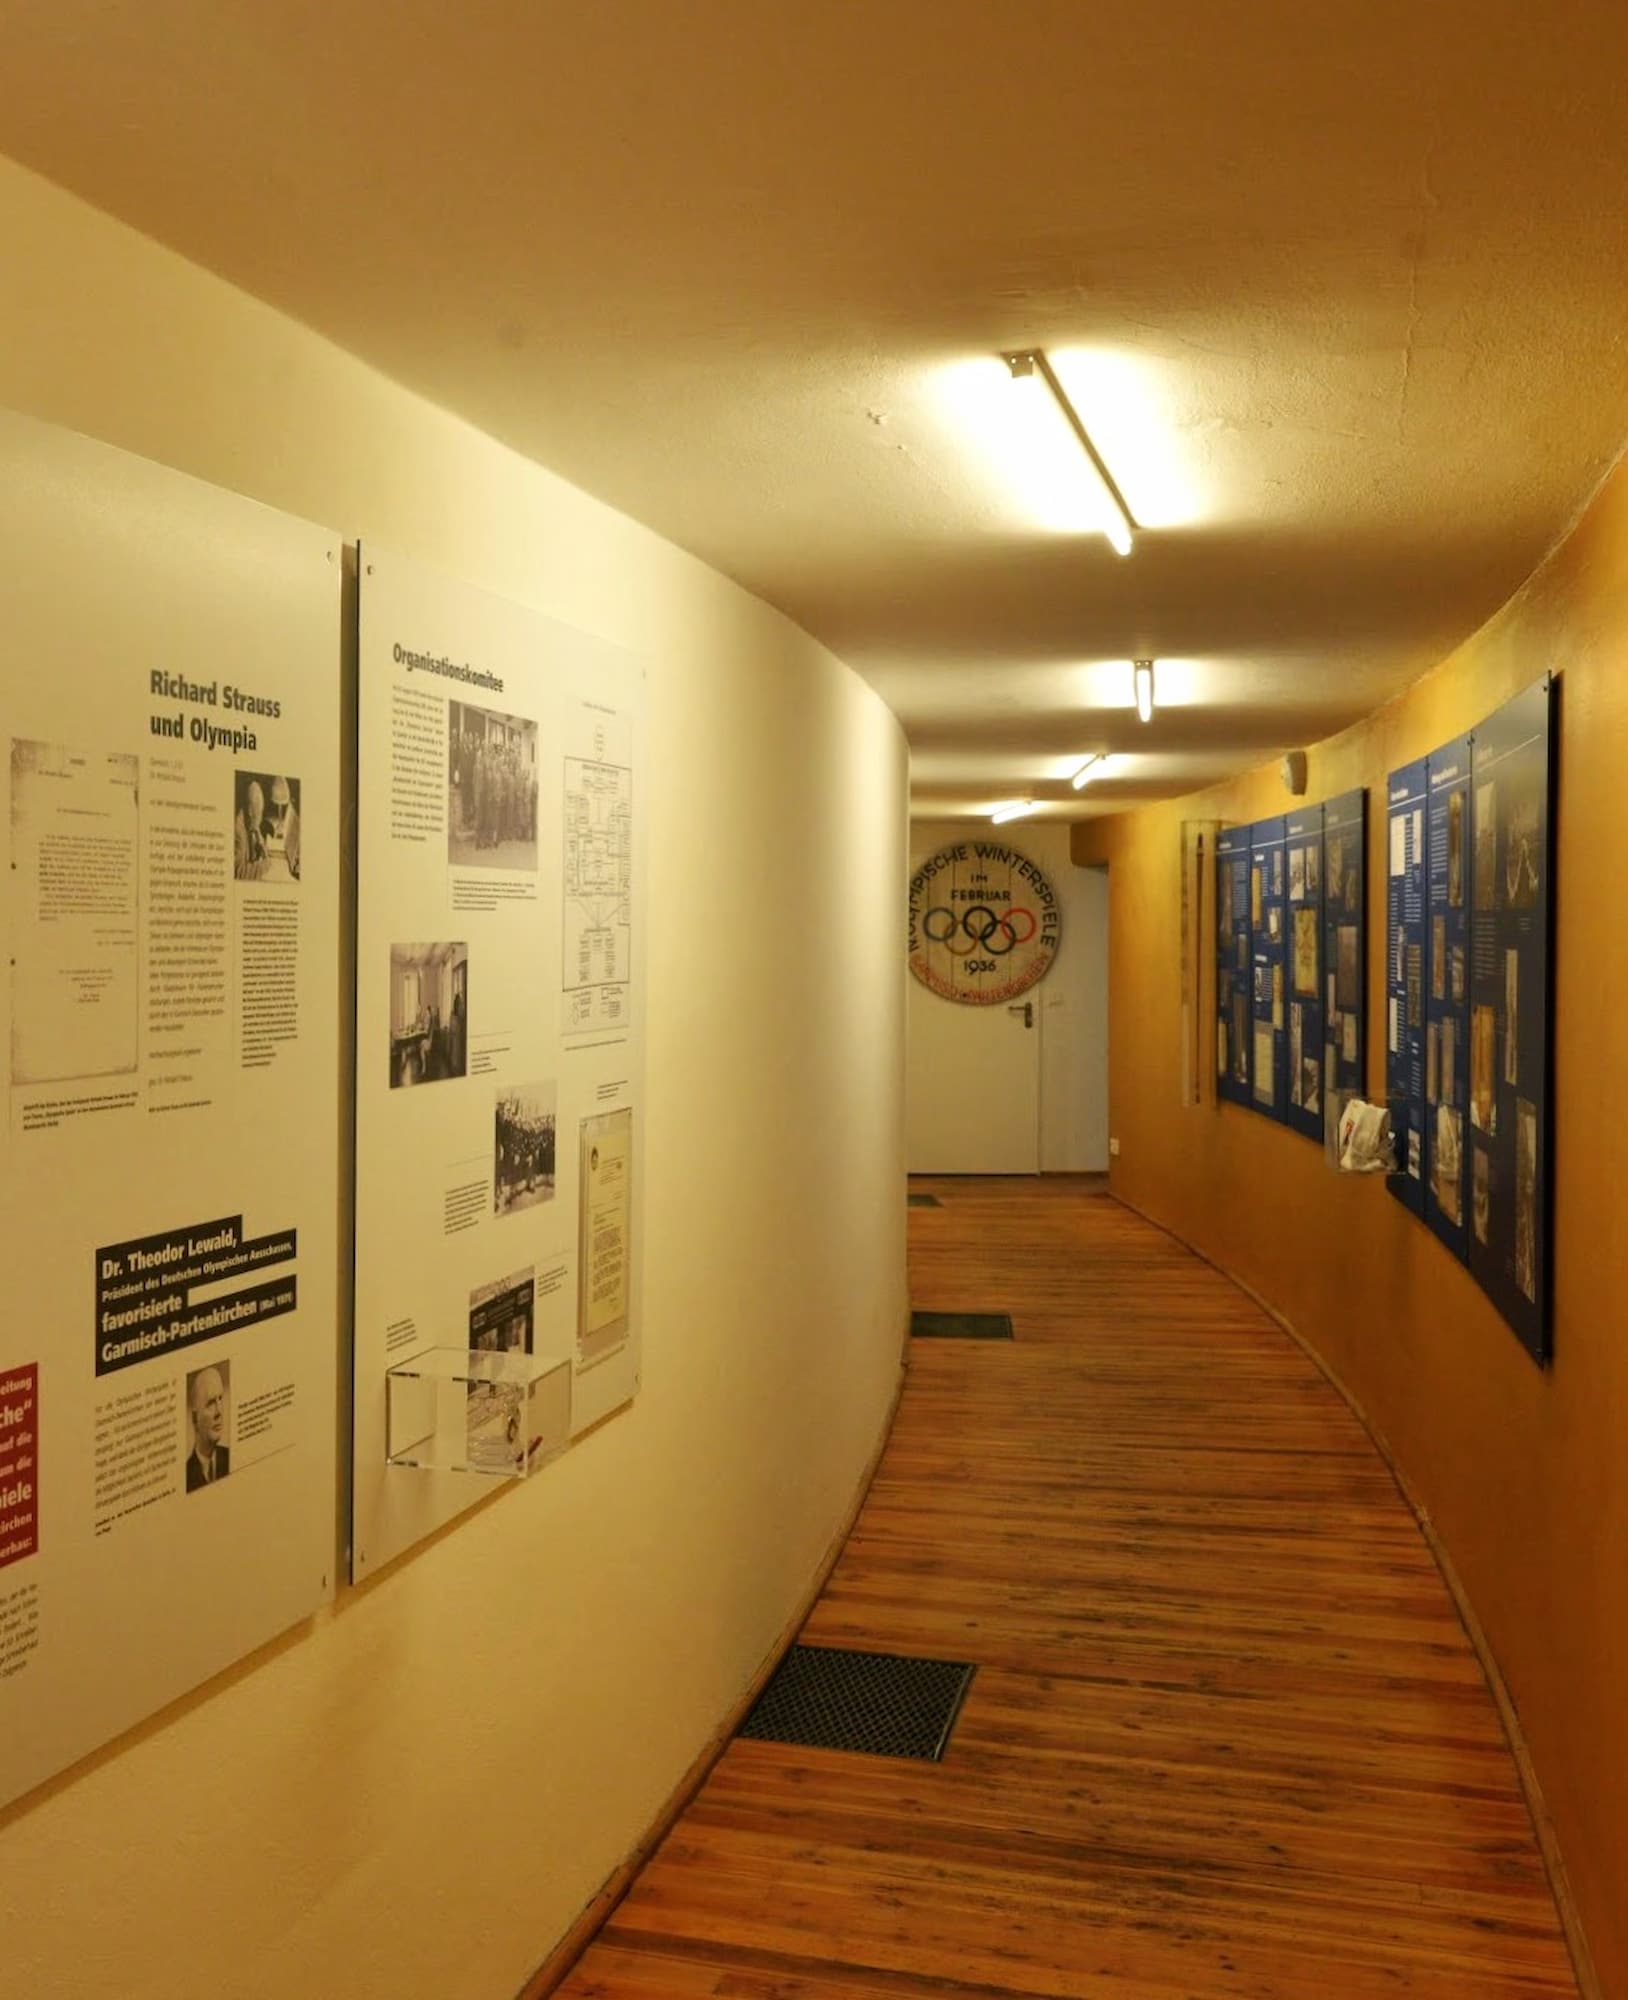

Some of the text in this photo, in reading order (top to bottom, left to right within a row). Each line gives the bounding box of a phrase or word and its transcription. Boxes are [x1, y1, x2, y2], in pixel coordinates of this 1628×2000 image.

[393, 642, 504, 693] Organisationskomitee
[150, 669, 281, 719] Richard Strauss
[150, 713, 257, 754] und Olympia
[951, 888, 1012, 902] FEBRUAR
[970, 873, 988, 883] IM
[974, 844, 1058, 950] WINTERSPIELE
[964, 959, 997, 976] 1936
[102, 1228, 237, 1280] Dr. Theodor Lewald,
[102, 1281, 144, 1303] Präsident
[145, 1275, 160, 1290] des
[161, 1265, 202, 1285] Deutschen
[203, 1254, 249, 1275] Olympischen
[102, 1295, 182, 1333] favorisierte
[102, 1300, 257, 1363] Garmisch-Partenkirchen
